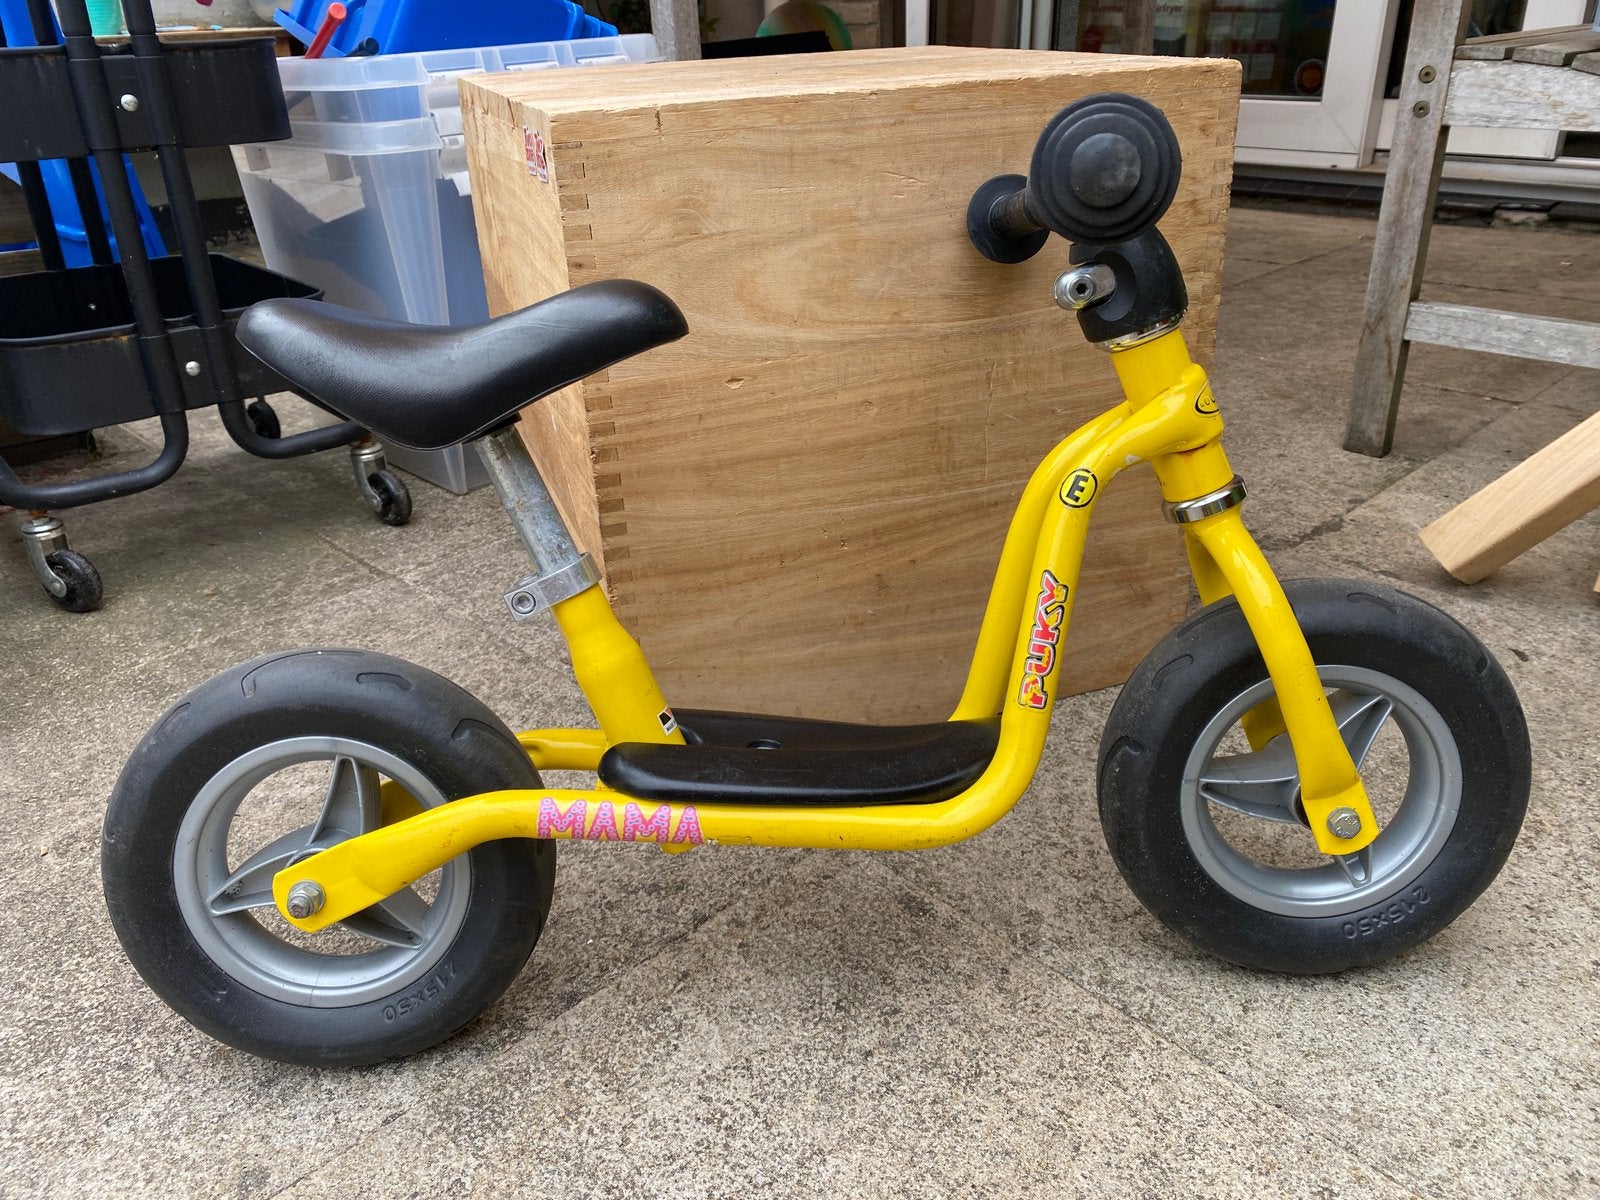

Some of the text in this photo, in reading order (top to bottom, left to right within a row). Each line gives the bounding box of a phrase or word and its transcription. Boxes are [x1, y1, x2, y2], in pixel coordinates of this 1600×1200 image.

[1066, 474, 1089, 503] E
[1018, 569, 1068, 709] PUKY
[538, 797, 704, 844] MAMA
